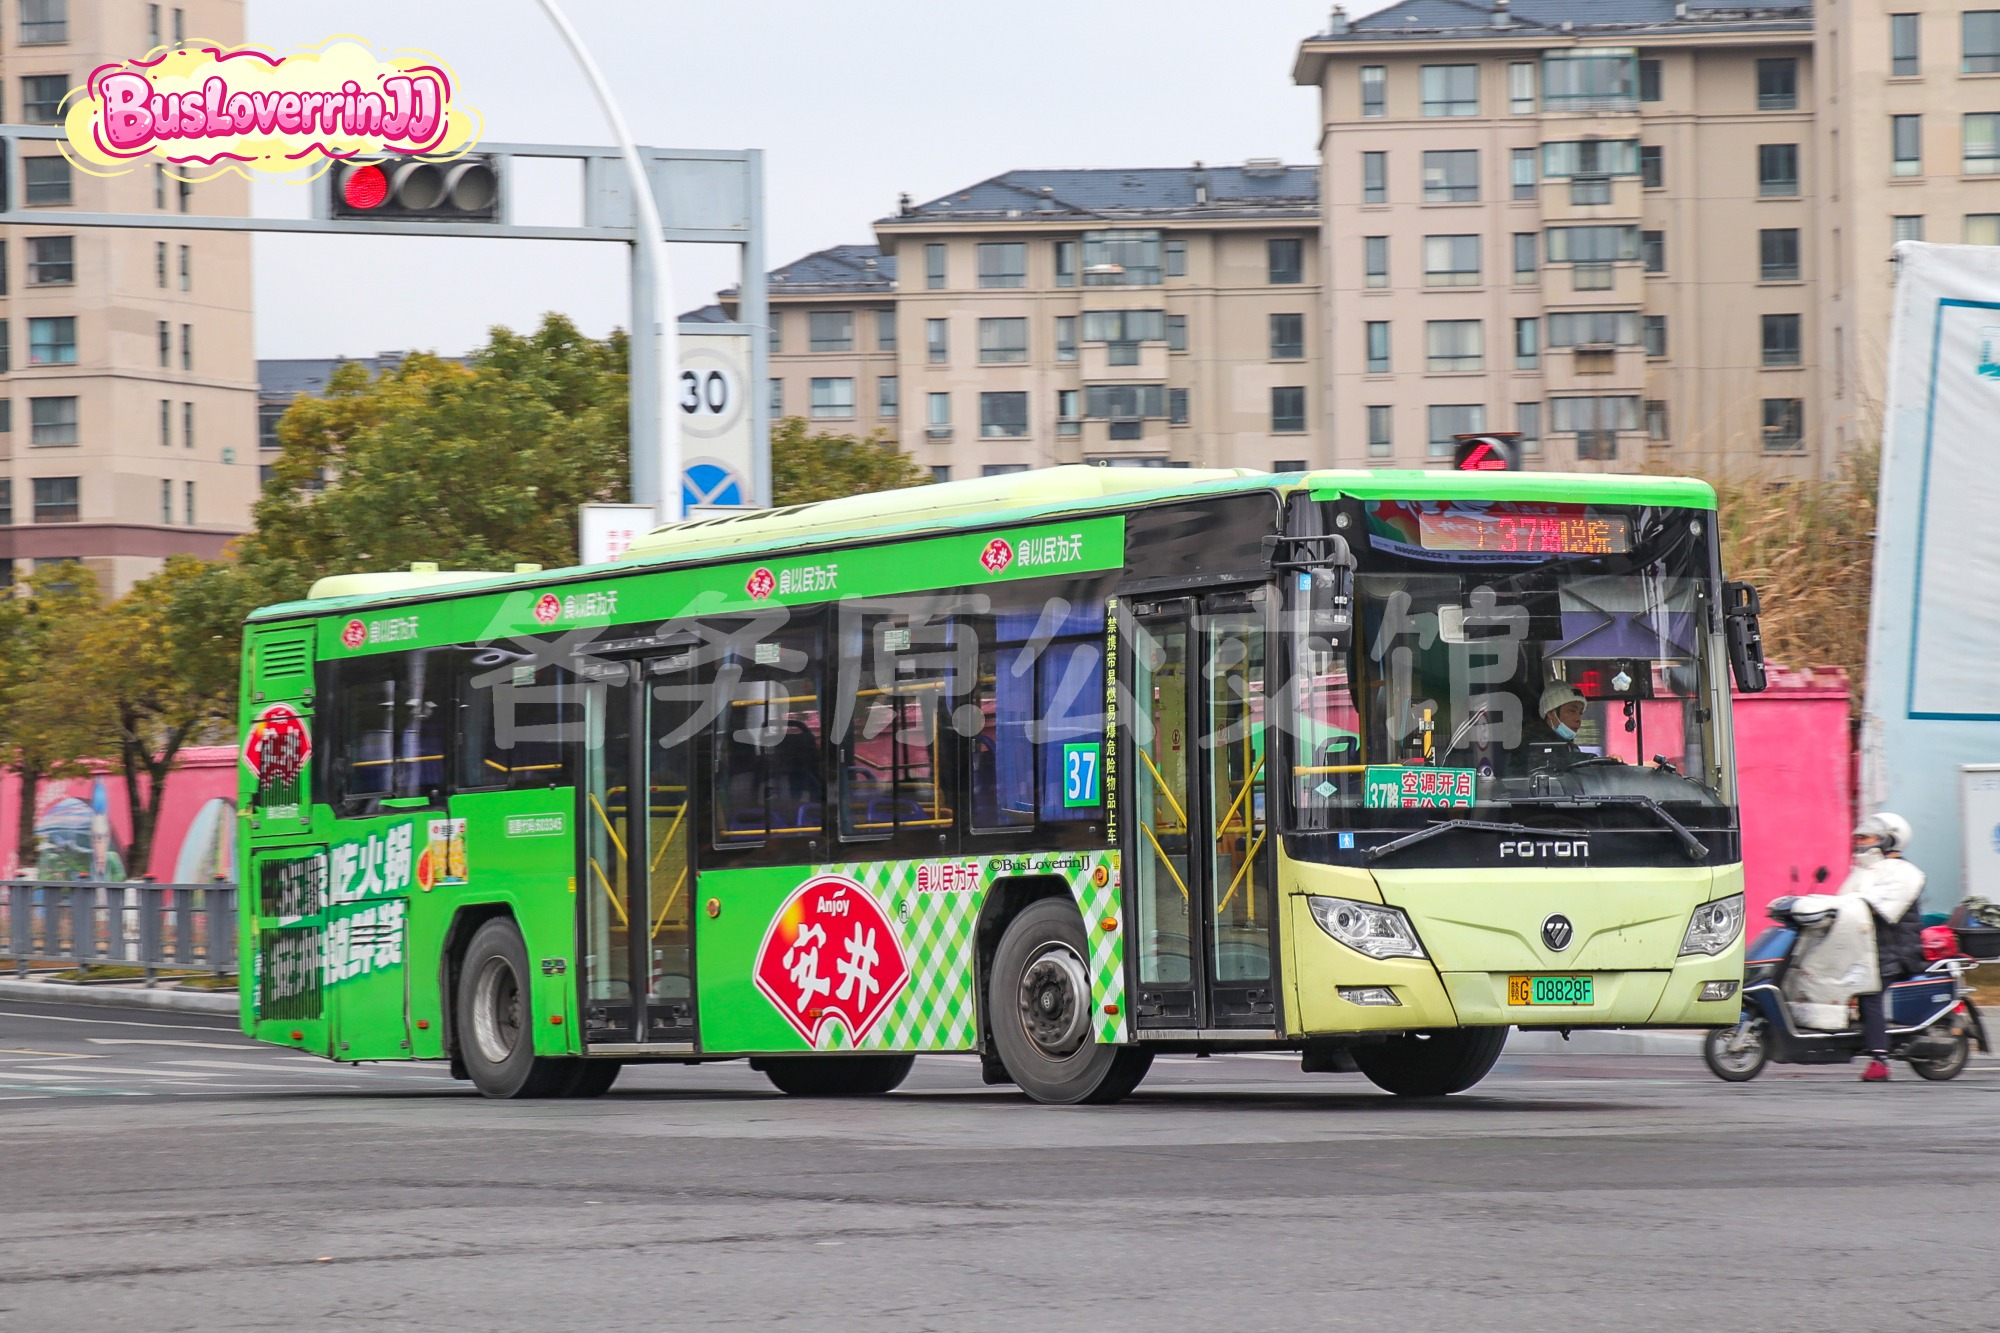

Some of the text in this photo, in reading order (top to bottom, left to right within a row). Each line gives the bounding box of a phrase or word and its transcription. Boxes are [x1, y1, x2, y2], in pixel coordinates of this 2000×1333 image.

[680, 370, 727, 414] 30
[1017, 533, 1083, 567] 食以民为天
[1500, 517, 1561, 552] 37路
[779, 563, 839, 595] 食以民为天
[1106, 598, 1118, 845] 严禁携带易燃易爆危险物品上车
[1068, 750, 1096, 799] 37
[1402, 771, 1472, 796] 空调开启
[1500, 841, 1589, 858] FOTON
[917, 863, 980, 892] 食以民为天
[816, 888, 850, 917] Anjoy
[782, 921, 880, 1013] 安井
[1536, 980, 1591, 1001] 08828F
